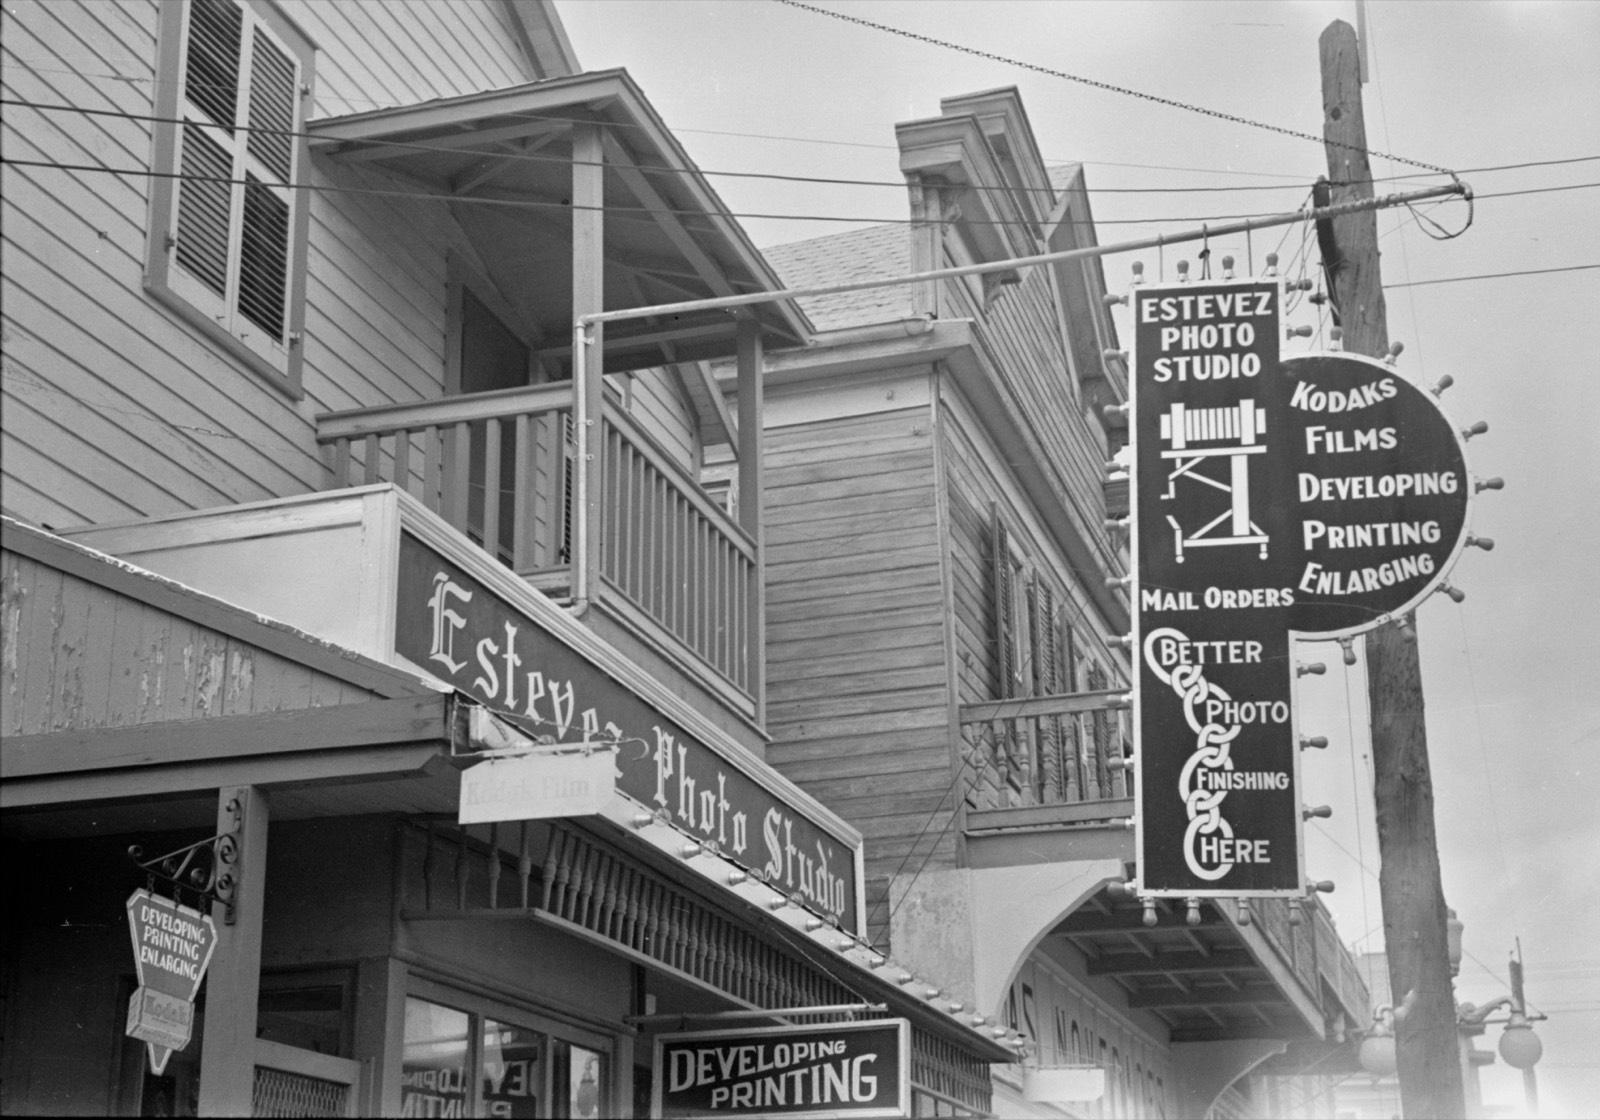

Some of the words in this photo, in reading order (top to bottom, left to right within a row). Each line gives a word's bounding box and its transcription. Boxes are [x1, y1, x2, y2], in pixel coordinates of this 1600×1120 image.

[1141, 292, 1272, 323] ESTEVEZ
[1161, 322, 1255, 351] PHOTO
[1153, 352, 1261, 382] STUDIO
[1289, 378, 1398, 413] KODAKS
[1305, 425, 1397, 455] FILMS
[1298, 471, 1458, 502] DEVELOPING
[1303, 520, 1441, 550] PRINTING
[1298, 552, 1435, 595] ENLARGING
[1142, 588, 1199, 612] MAIL
[1204, 586, 1295, 609] ORDERS
[1161, 641, 1263, 666] BETTER
[1206, 701, 1289, 724] PHOTO
[1197, 768, 1290, 791] FINISHING
[652, 725, 748, 855] Photo
[763, 806, 846, 918] Studio
[1201, 836, 1271, 864] HERE
[141, 905, 206, 944] DEVELOPING
[143, 925, 199, 961] PRINTING
[141, 945, 198, 981] ENLARGING
[668, 1040, 847, 1092] DEVELOPING
[711, 1053, 878, 1108] PRINTING
